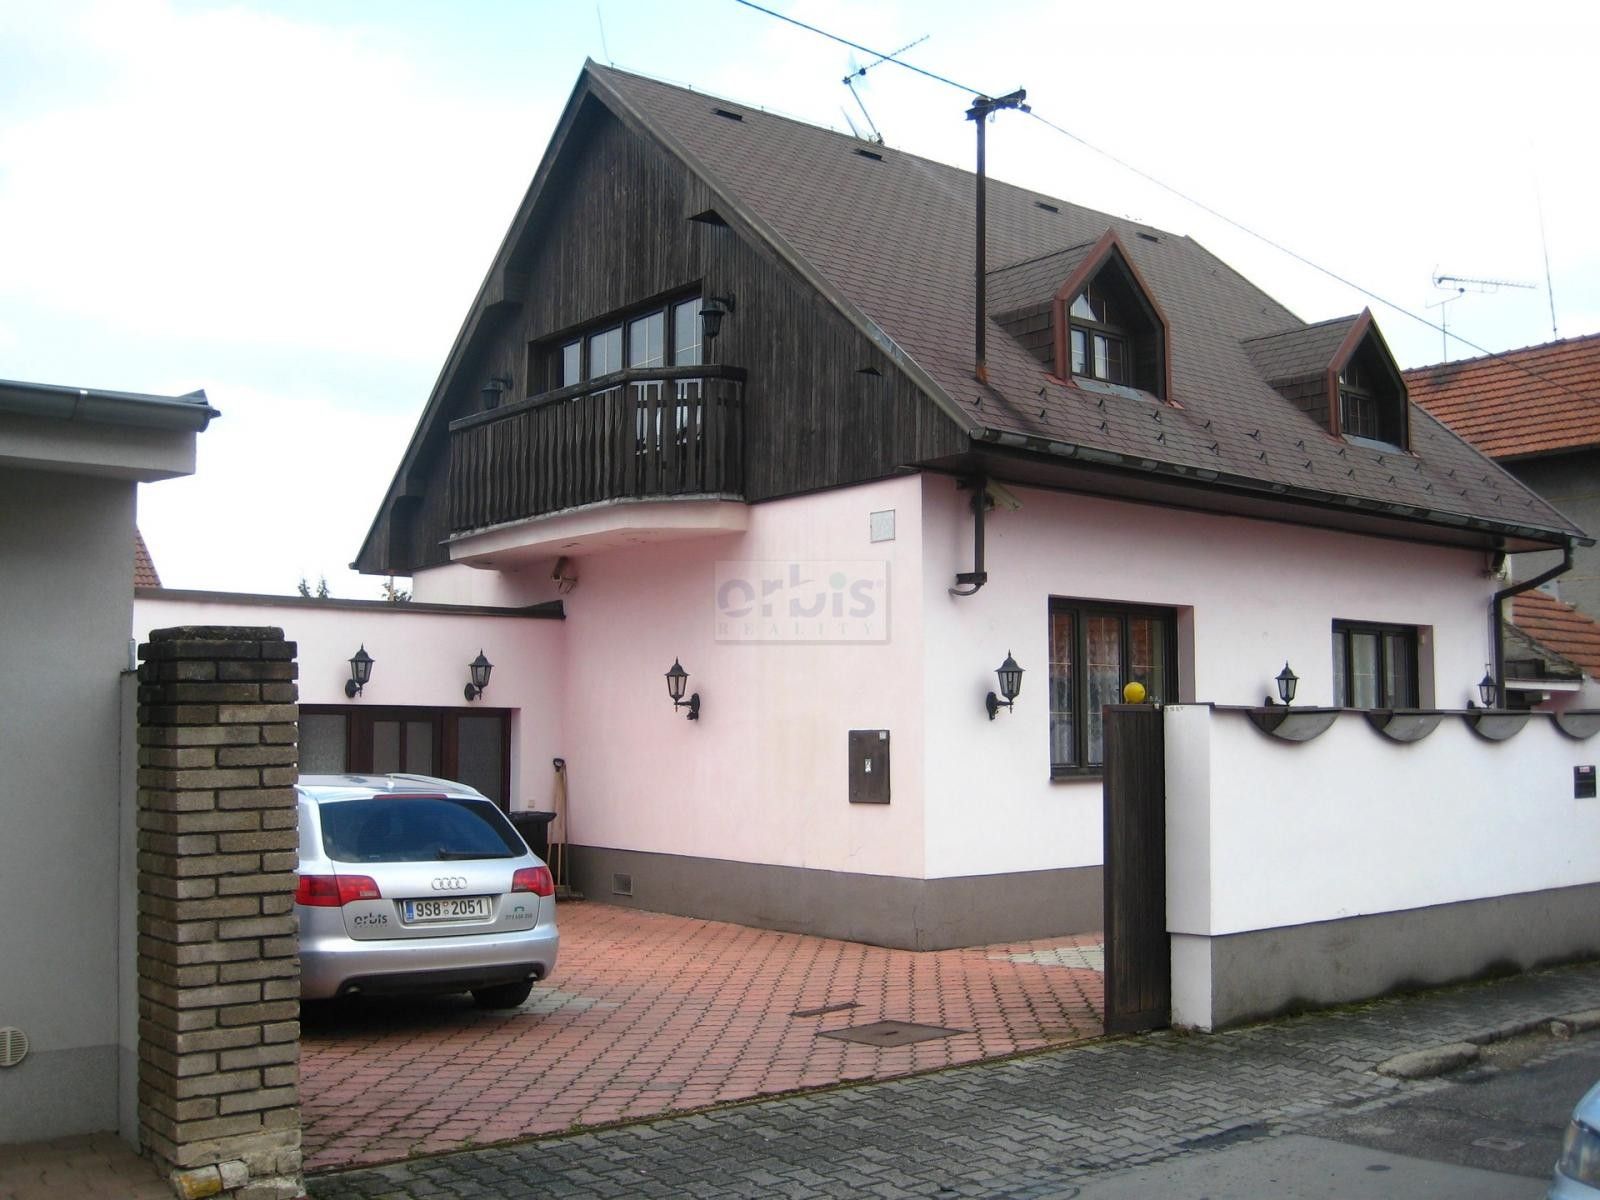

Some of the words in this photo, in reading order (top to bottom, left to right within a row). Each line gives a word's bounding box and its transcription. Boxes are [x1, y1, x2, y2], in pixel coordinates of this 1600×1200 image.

[416, 902, 441, 917] 9S8
[451, 900, 483, 915] 2051
[354, 912, 388, 925] orbis
